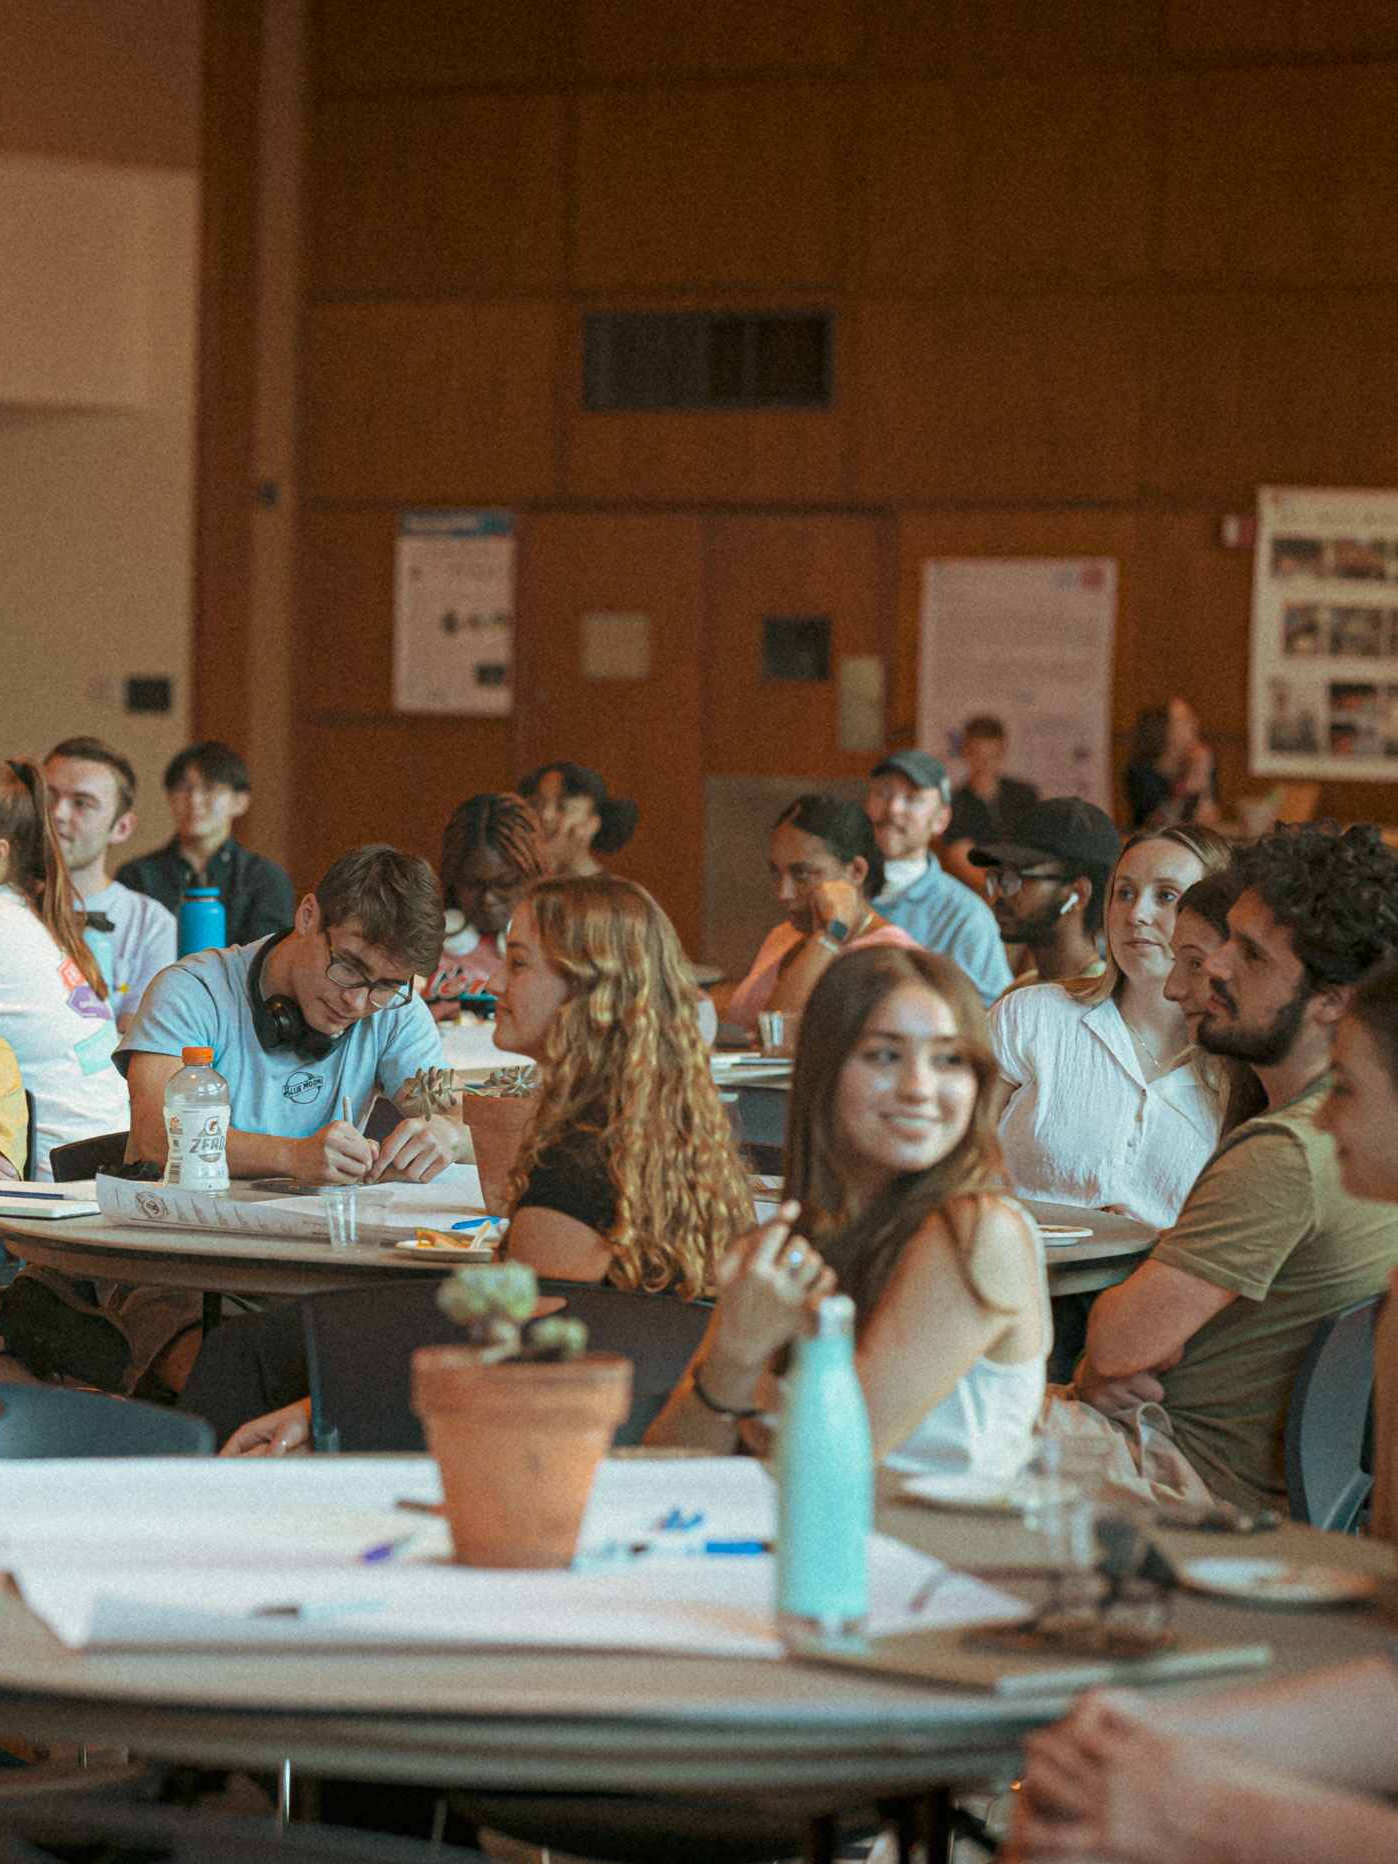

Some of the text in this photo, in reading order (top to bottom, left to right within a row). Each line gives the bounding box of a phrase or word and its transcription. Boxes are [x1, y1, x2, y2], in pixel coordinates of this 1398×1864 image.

[283, 1079, 322, 1098] BLUE MOON
[189, 1136, 225, 1153] ZERO
